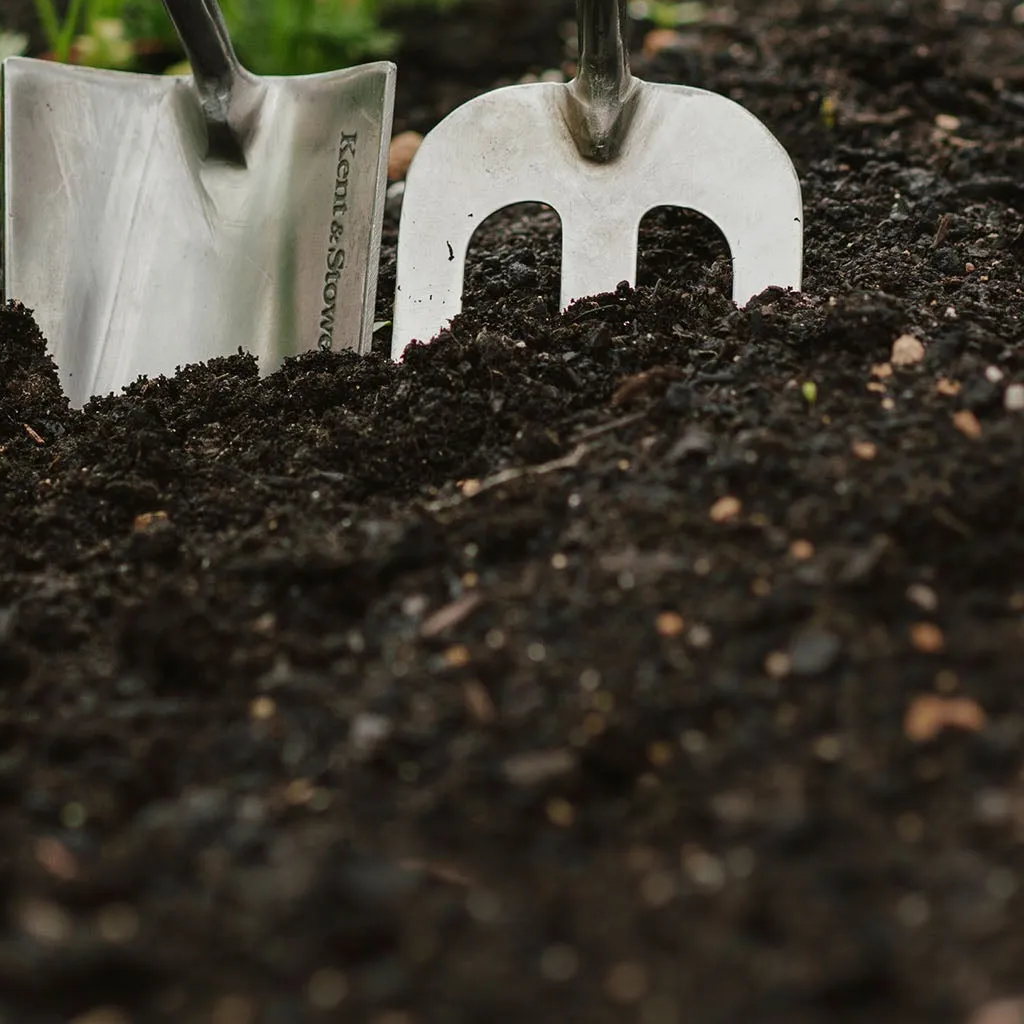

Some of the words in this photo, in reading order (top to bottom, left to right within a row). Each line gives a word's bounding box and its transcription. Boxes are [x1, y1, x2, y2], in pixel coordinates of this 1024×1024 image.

[332, 130, 358, 217] Kent
[329, 220, 344, 244] &
[317, 247, 346, 352] Stowe
